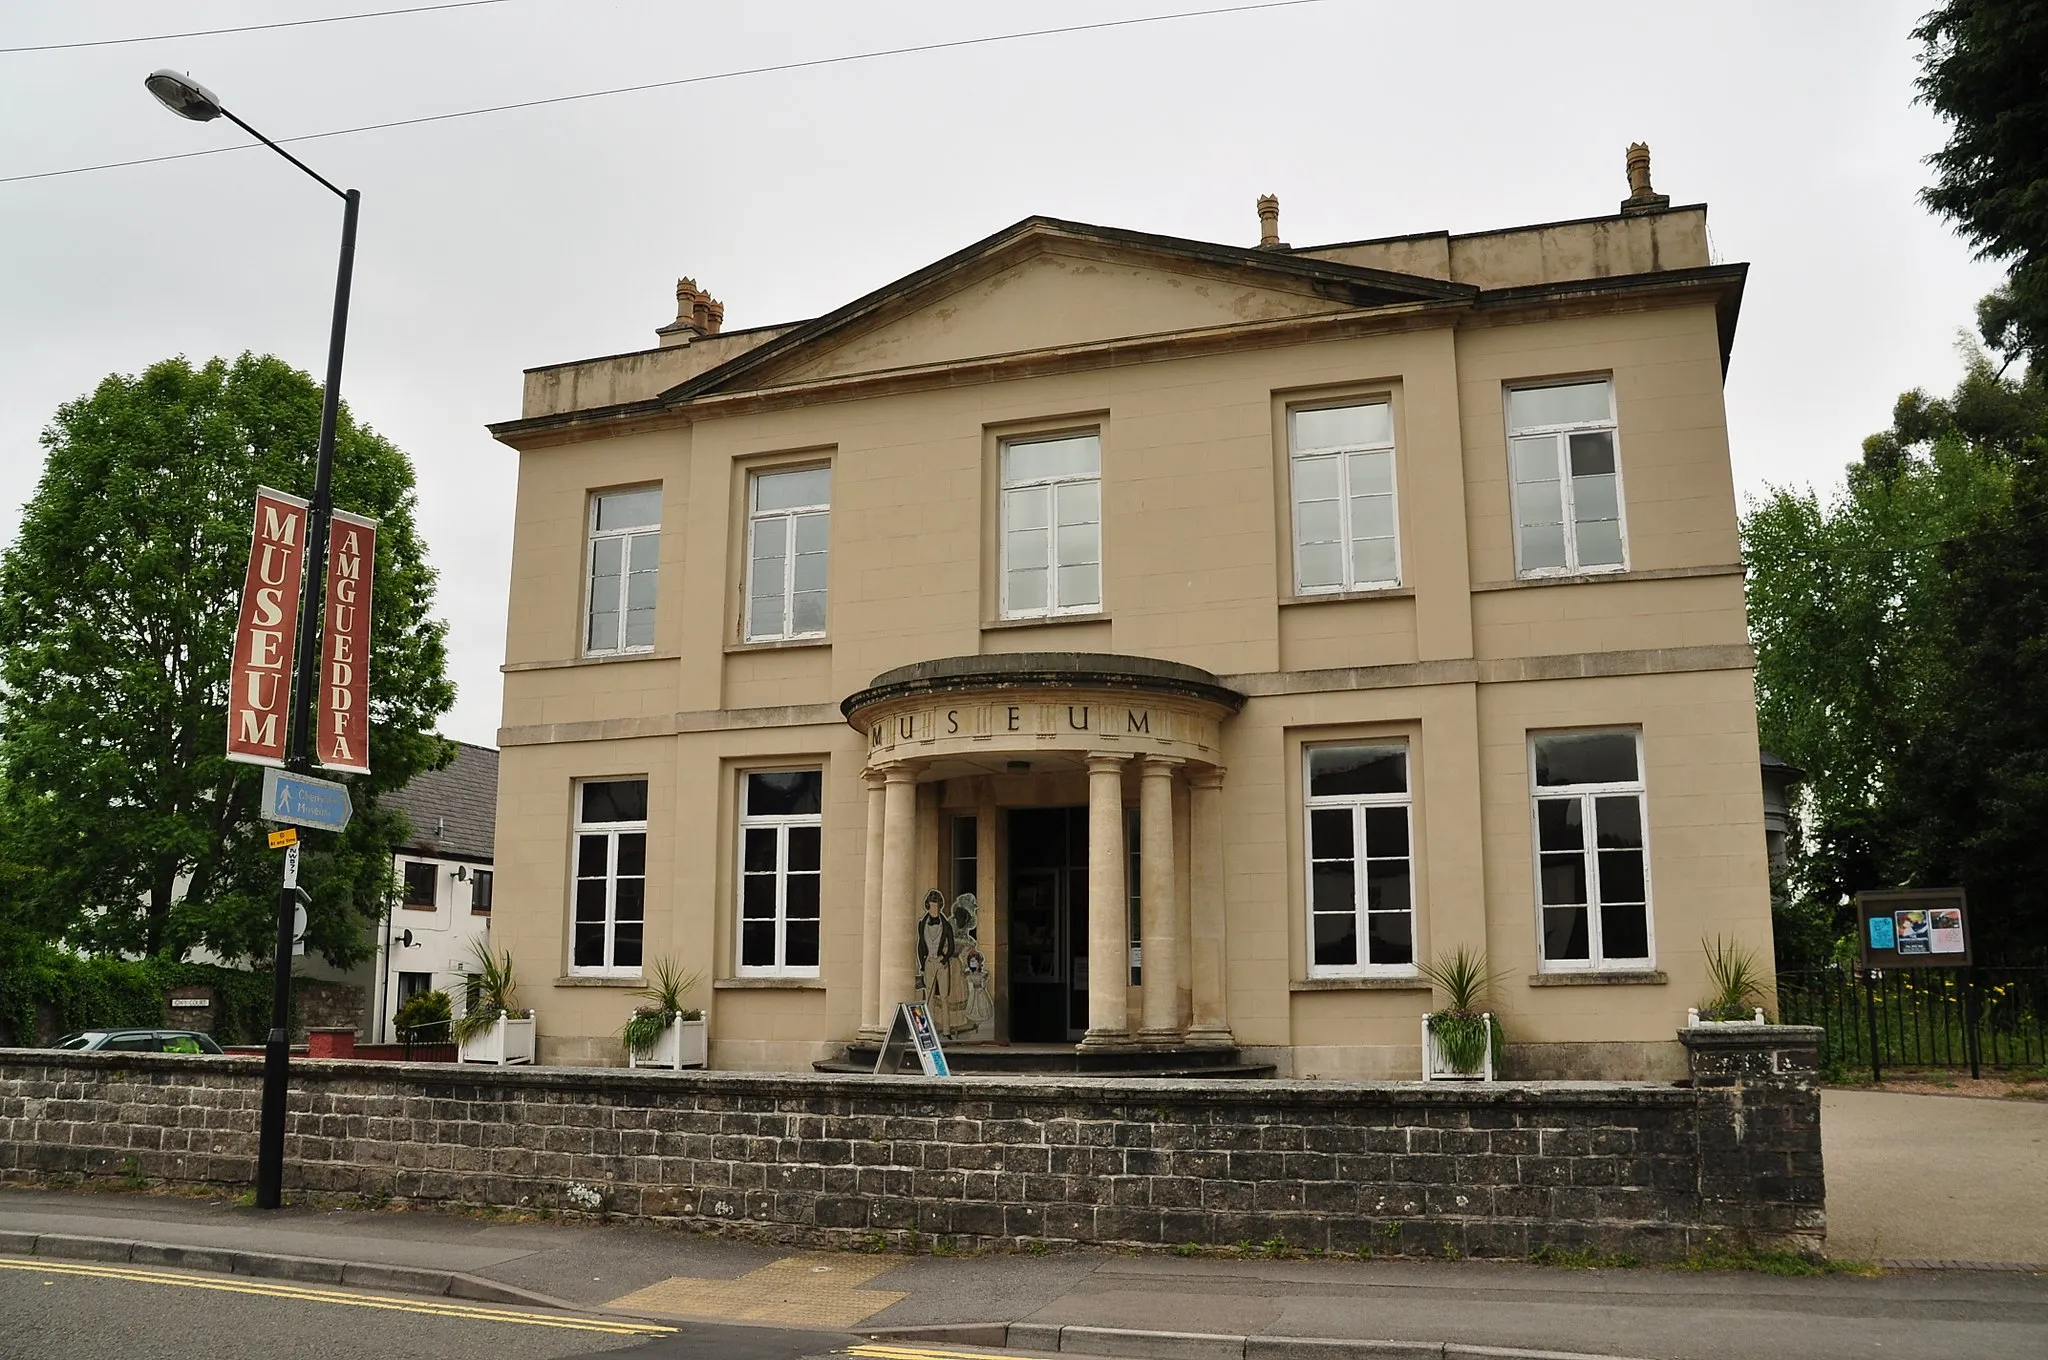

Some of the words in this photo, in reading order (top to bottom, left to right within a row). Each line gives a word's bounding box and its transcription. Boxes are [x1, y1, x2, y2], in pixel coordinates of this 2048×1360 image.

[238, 505, 299, 748] MUSEUM
[331, 530, 360, 760] AMGUEDDFA
[872, 706, 1150, 748] MUSEUM
